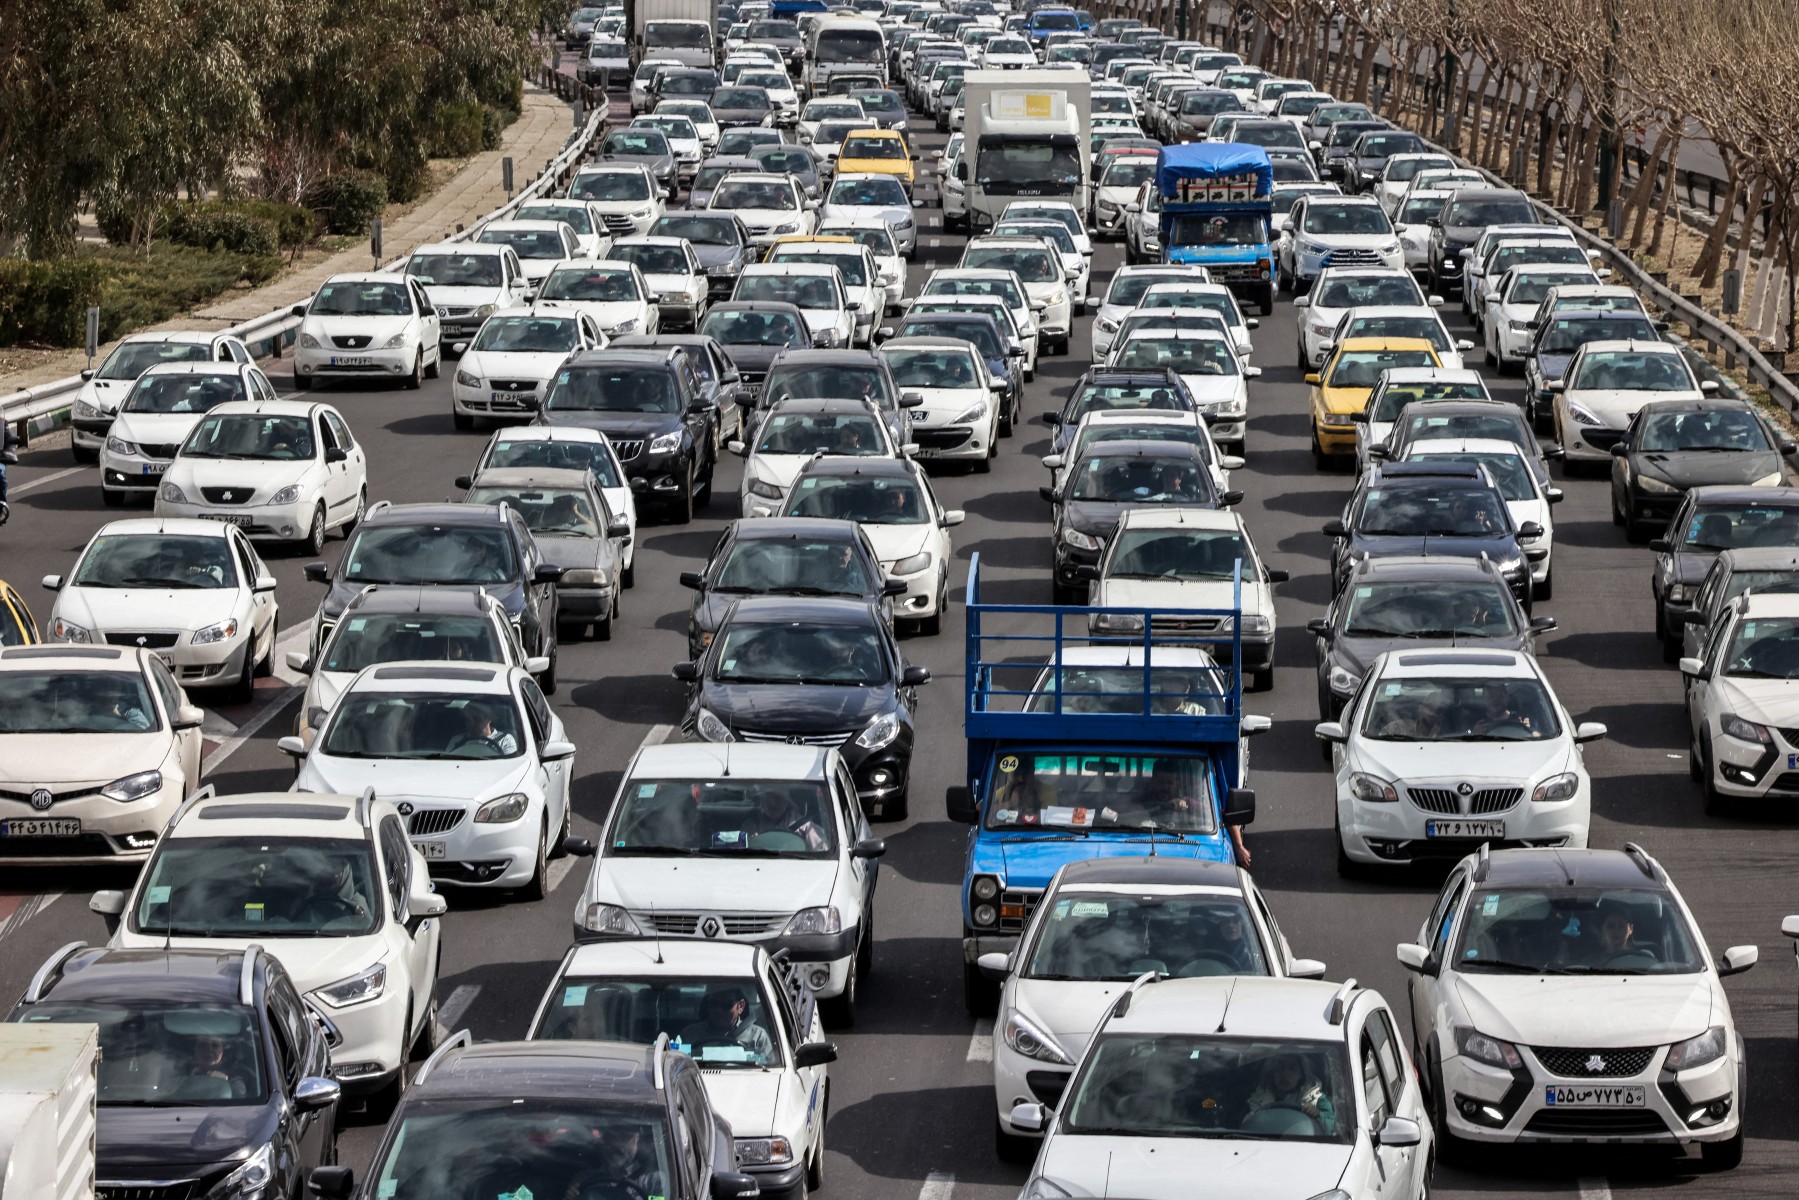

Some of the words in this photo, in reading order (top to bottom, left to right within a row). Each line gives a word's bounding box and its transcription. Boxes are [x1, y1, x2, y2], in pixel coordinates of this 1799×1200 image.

[1001, 759, 1017, 769] 94
[430, 845, 443, 857] ۴۰
[1625, 1091, 1643, 1104] ۵۰
